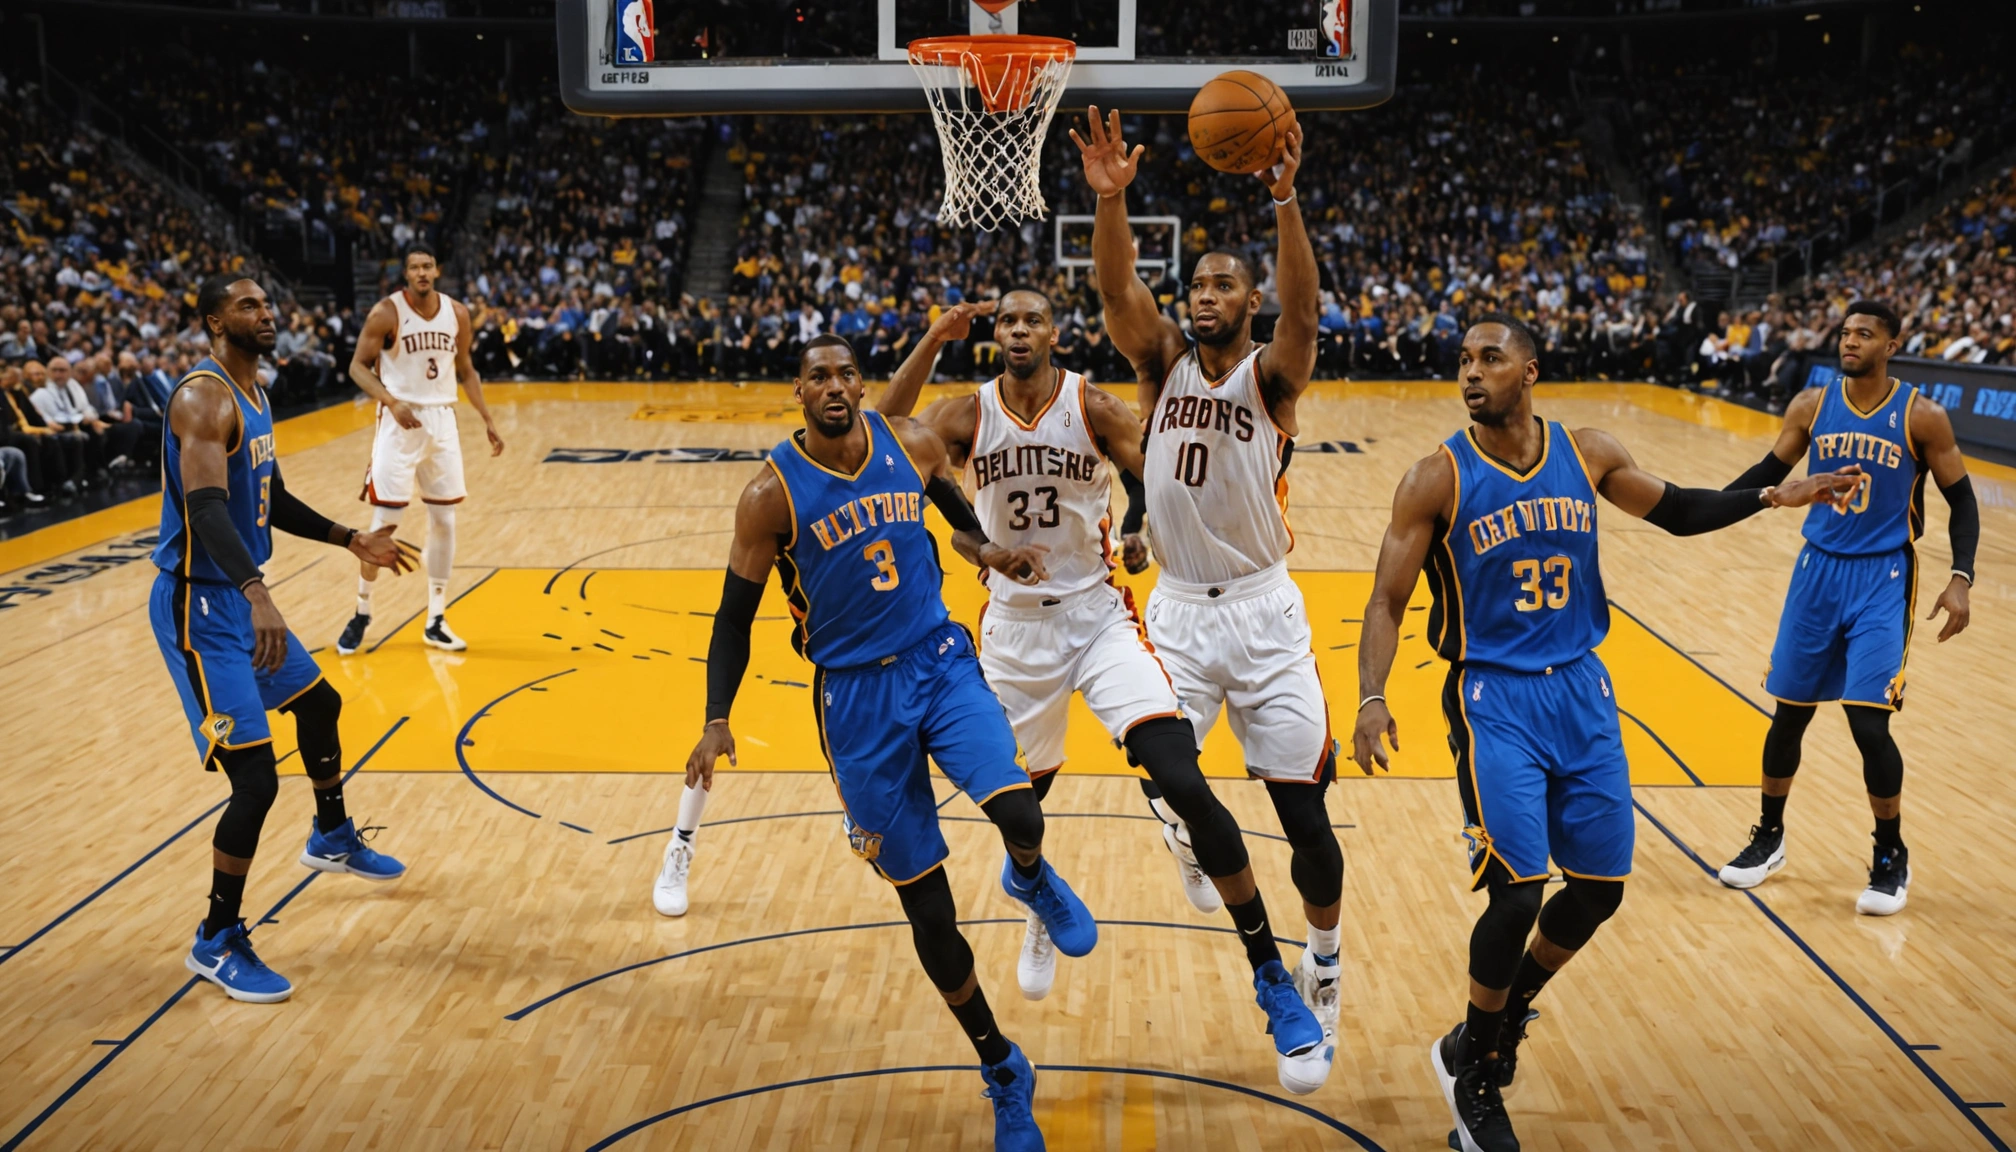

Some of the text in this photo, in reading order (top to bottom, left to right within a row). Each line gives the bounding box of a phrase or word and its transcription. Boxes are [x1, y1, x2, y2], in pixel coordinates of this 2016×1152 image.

[1174, 441, 1208, 487] 10
[1007, 486, 1060, 531] 33
[863, 539, 900, 591] 3
[1512, 554, 1572, 612] 33
